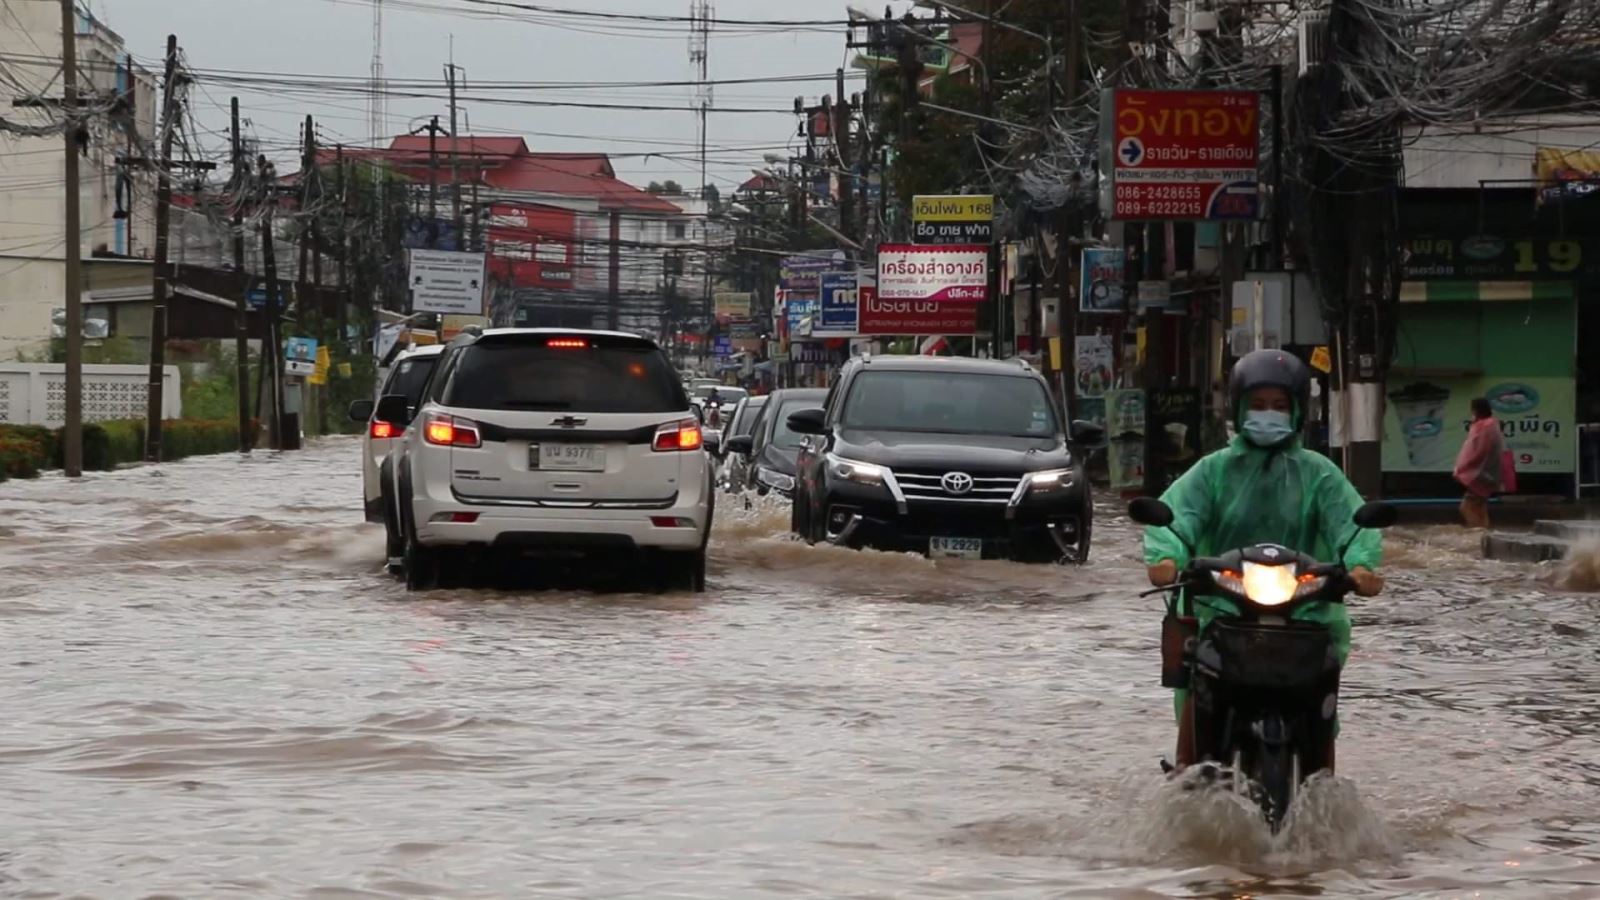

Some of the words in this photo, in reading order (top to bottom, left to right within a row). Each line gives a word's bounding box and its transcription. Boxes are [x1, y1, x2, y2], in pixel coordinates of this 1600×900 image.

[1118, 96, 1256, 136] วังทอง
[969, 203, 992, 215] 168
[1116, 202, 1201, 214] 089-6222215
[881, 255, 984, 275] เครื่องสำอางค์
